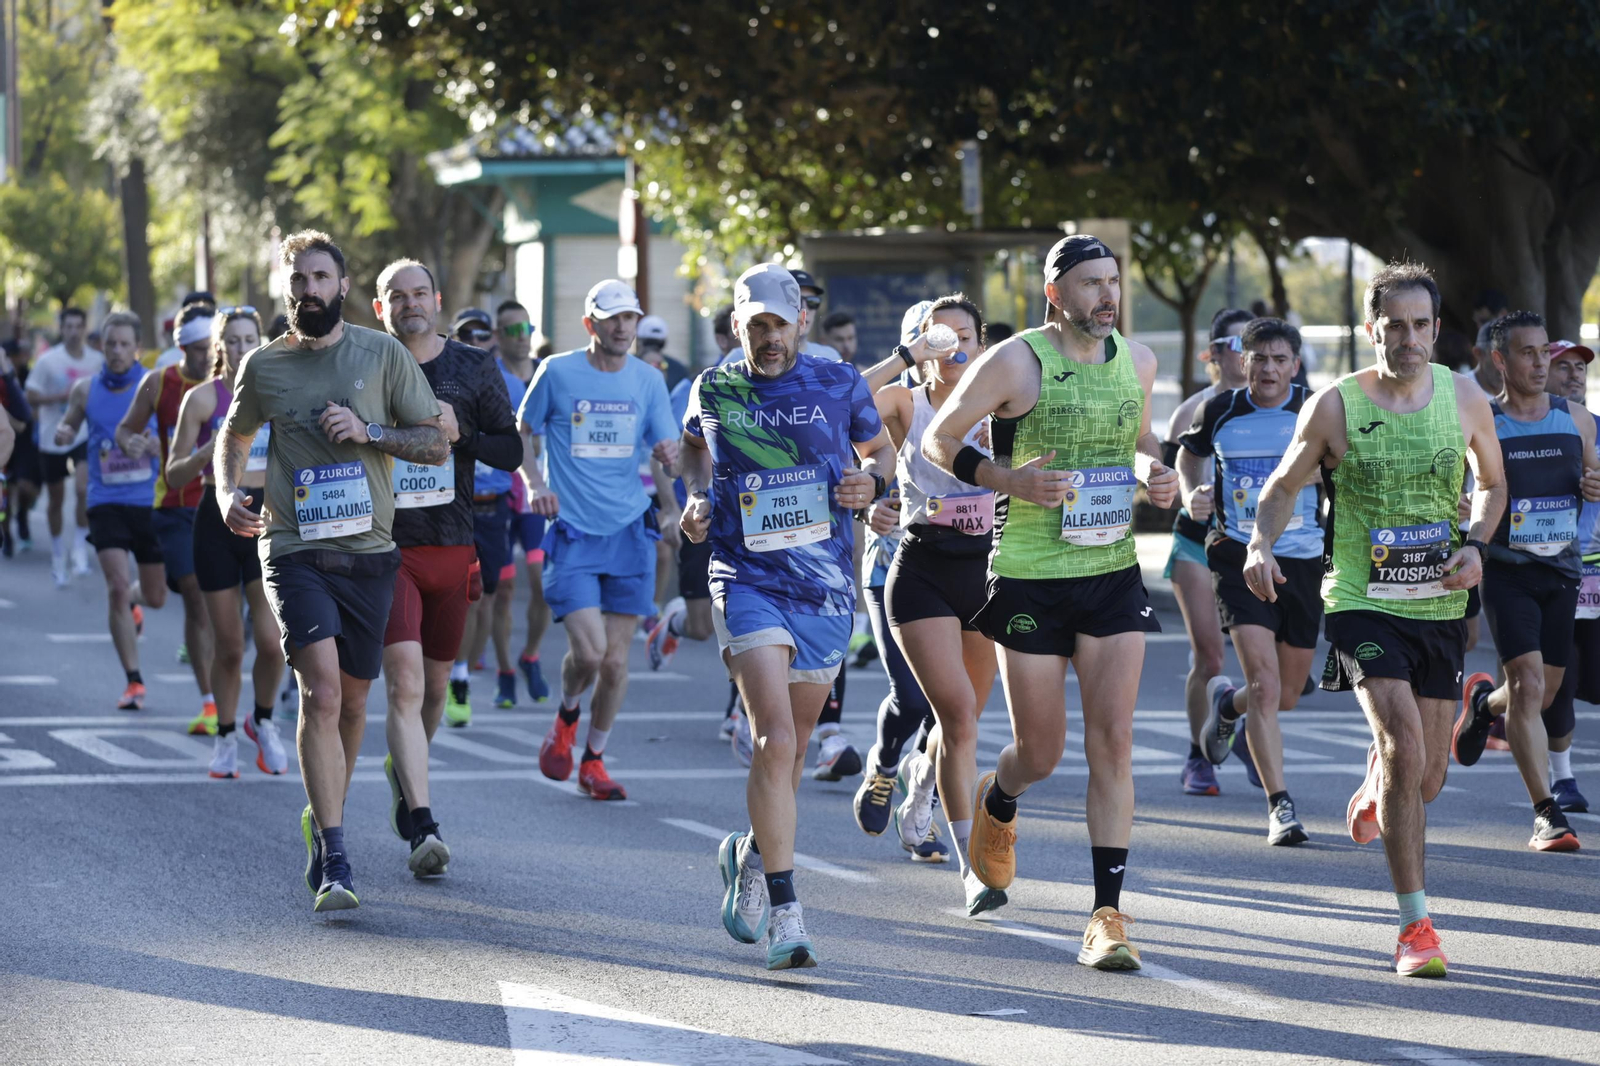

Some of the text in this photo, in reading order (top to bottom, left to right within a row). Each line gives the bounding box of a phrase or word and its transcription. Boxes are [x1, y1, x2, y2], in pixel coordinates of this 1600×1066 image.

[594, 403, 629, 412] ZURICH
[727, 404, 828, 428] RUNNEA
[588, 431, 618, 443] KENT
[1508, 448, 1562, 460] MEDIA LEGUA
[319, 466, 362, 480] ZURICH
[768, 469, 816, 485] ZURICH
[1089, 471, 1129, 483] ZURICH
[400, 476, 436, 491] COCO
[322, 489, 346, 501] 5484
[771, 495, 798, 508] 7813
[1090, 494, 1112, 506] 5688
[956, 504, 977, 514] 8811
[1535, 499, 1570, 510] ZURICH
[297, 500, 372, 523] GUILLAUME
[1063, 508, 1131, 528] ALEJANDRO
[761, 509, 813, 531] ANGEL
[952, 516, 984, 530] MAX
[1536, 518, 1555, 527] 7780
[1400, 526, 1442, 542] ZURICH
[1510, 530, 1576, 543] MIGUEL ÁNGEL
[1402, 552, 1427, 563] 3187
[1378, 563, 1444, 582] TXOSPAS
[1577, 592, 1600, 605] STO
